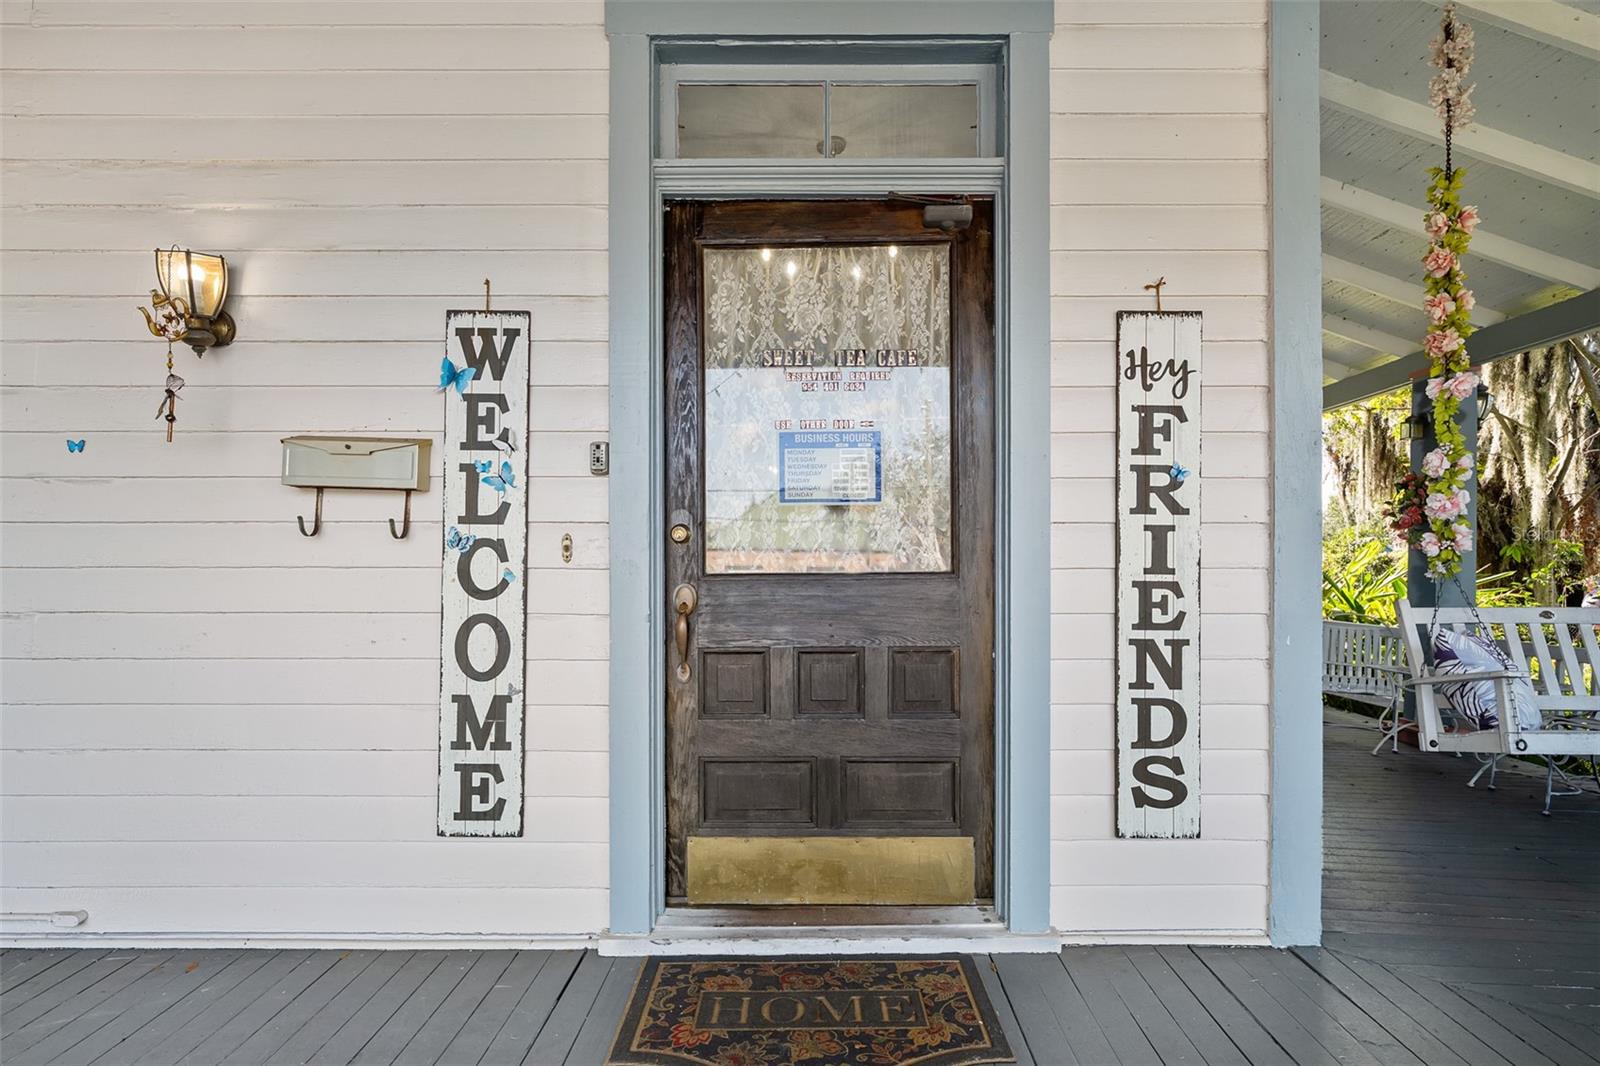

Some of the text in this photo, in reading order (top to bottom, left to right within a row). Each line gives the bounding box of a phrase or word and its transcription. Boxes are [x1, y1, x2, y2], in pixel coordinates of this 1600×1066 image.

[763, 350, 917, 367] SWEET TEA CAFE
[785, 371, 891, 381] RESERVATION REQUIRED
[1124, 346, 1197, 399] Hey
[775, 420, 791, 430] USE
[800, 420, 826, 430] OTHER
[794, 432, 874, 443] BUSINESS HOURS
[450, 327, 521, 821] WELCOME
[1128, 404, 1190, 809] FRIENDS
[707, 994, 918, 1025] HOME
